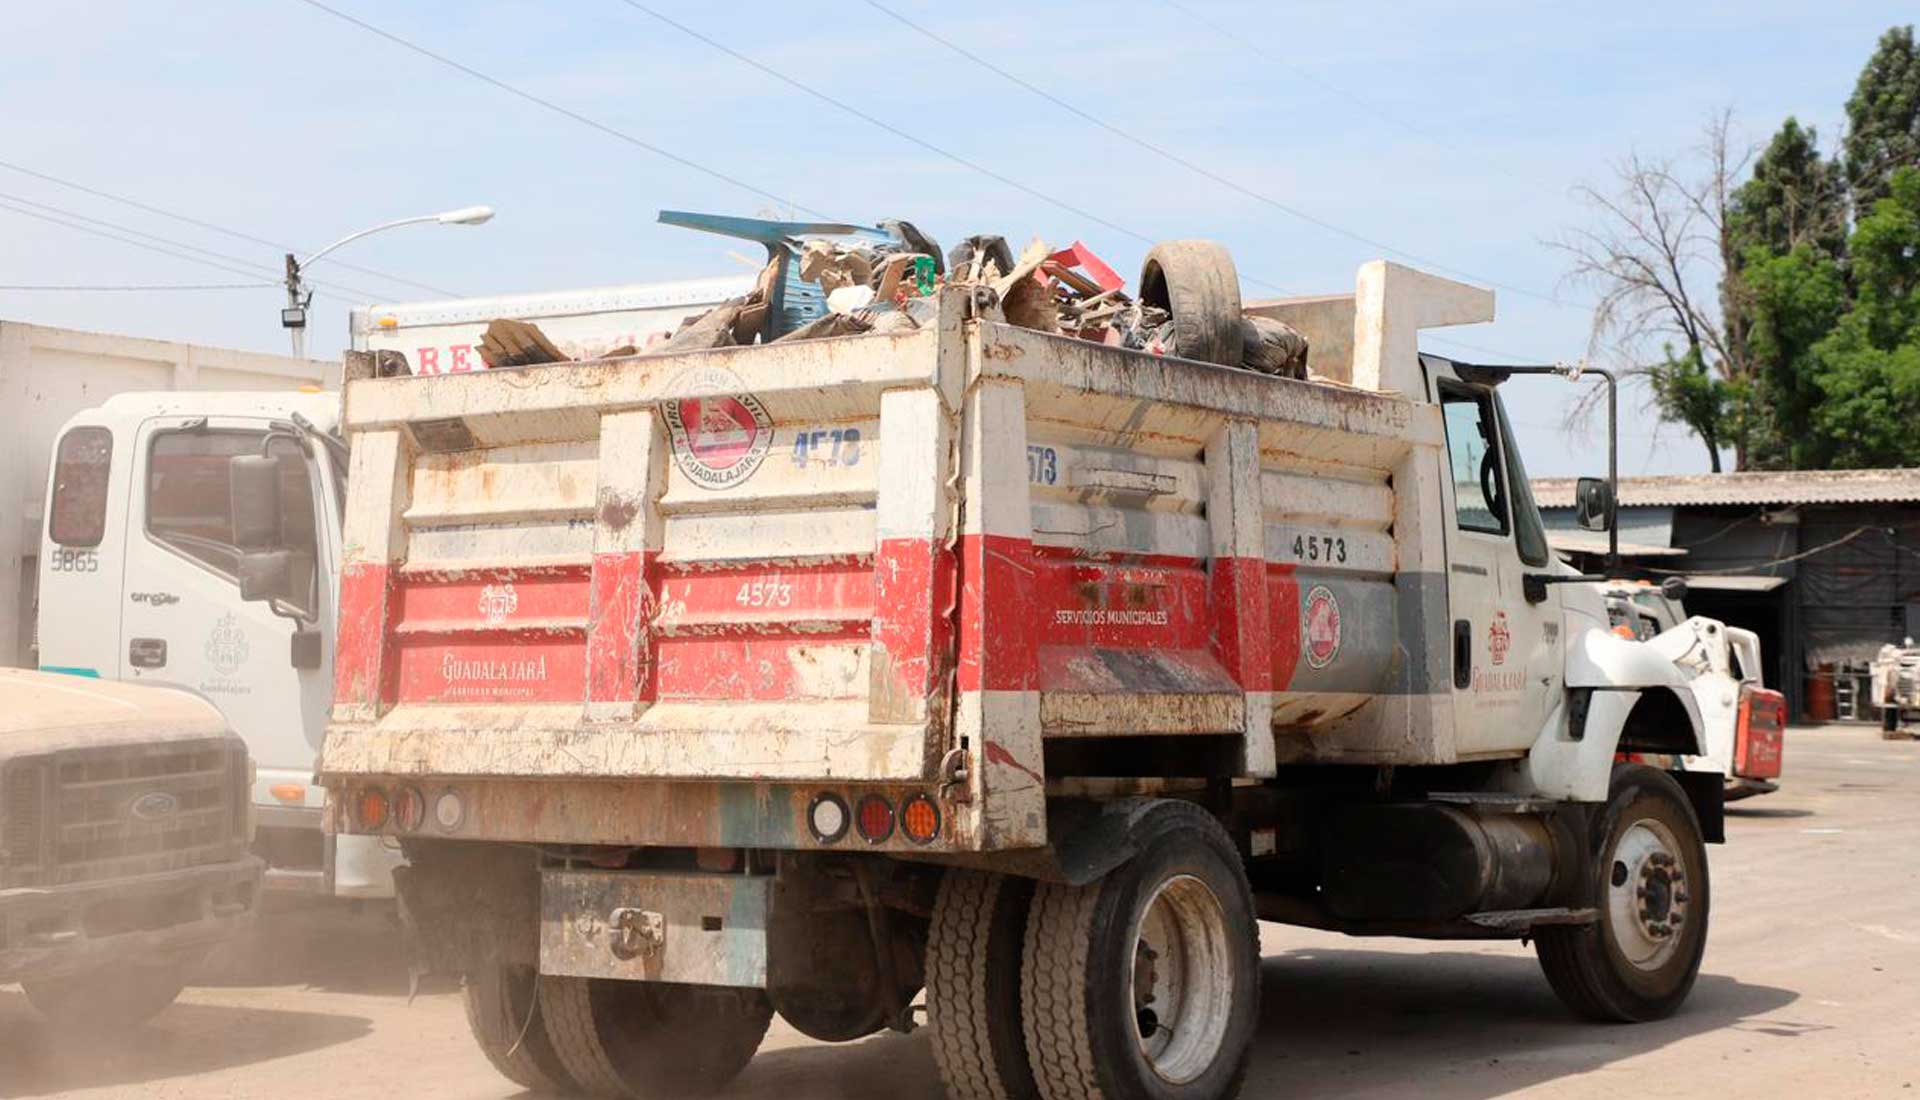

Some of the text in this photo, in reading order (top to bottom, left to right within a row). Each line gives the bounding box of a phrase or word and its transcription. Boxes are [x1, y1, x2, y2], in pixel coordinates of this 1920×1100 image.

[682, 447, 761, 484] GUADALAJARA
[1293, 534, 1347, 562] 4573
[50, 550, 99, 573] 5865
[735, 582, 792, 608] 4573
[1055, 609, 1169, 626] SERVICIOS MUNICIPALES
